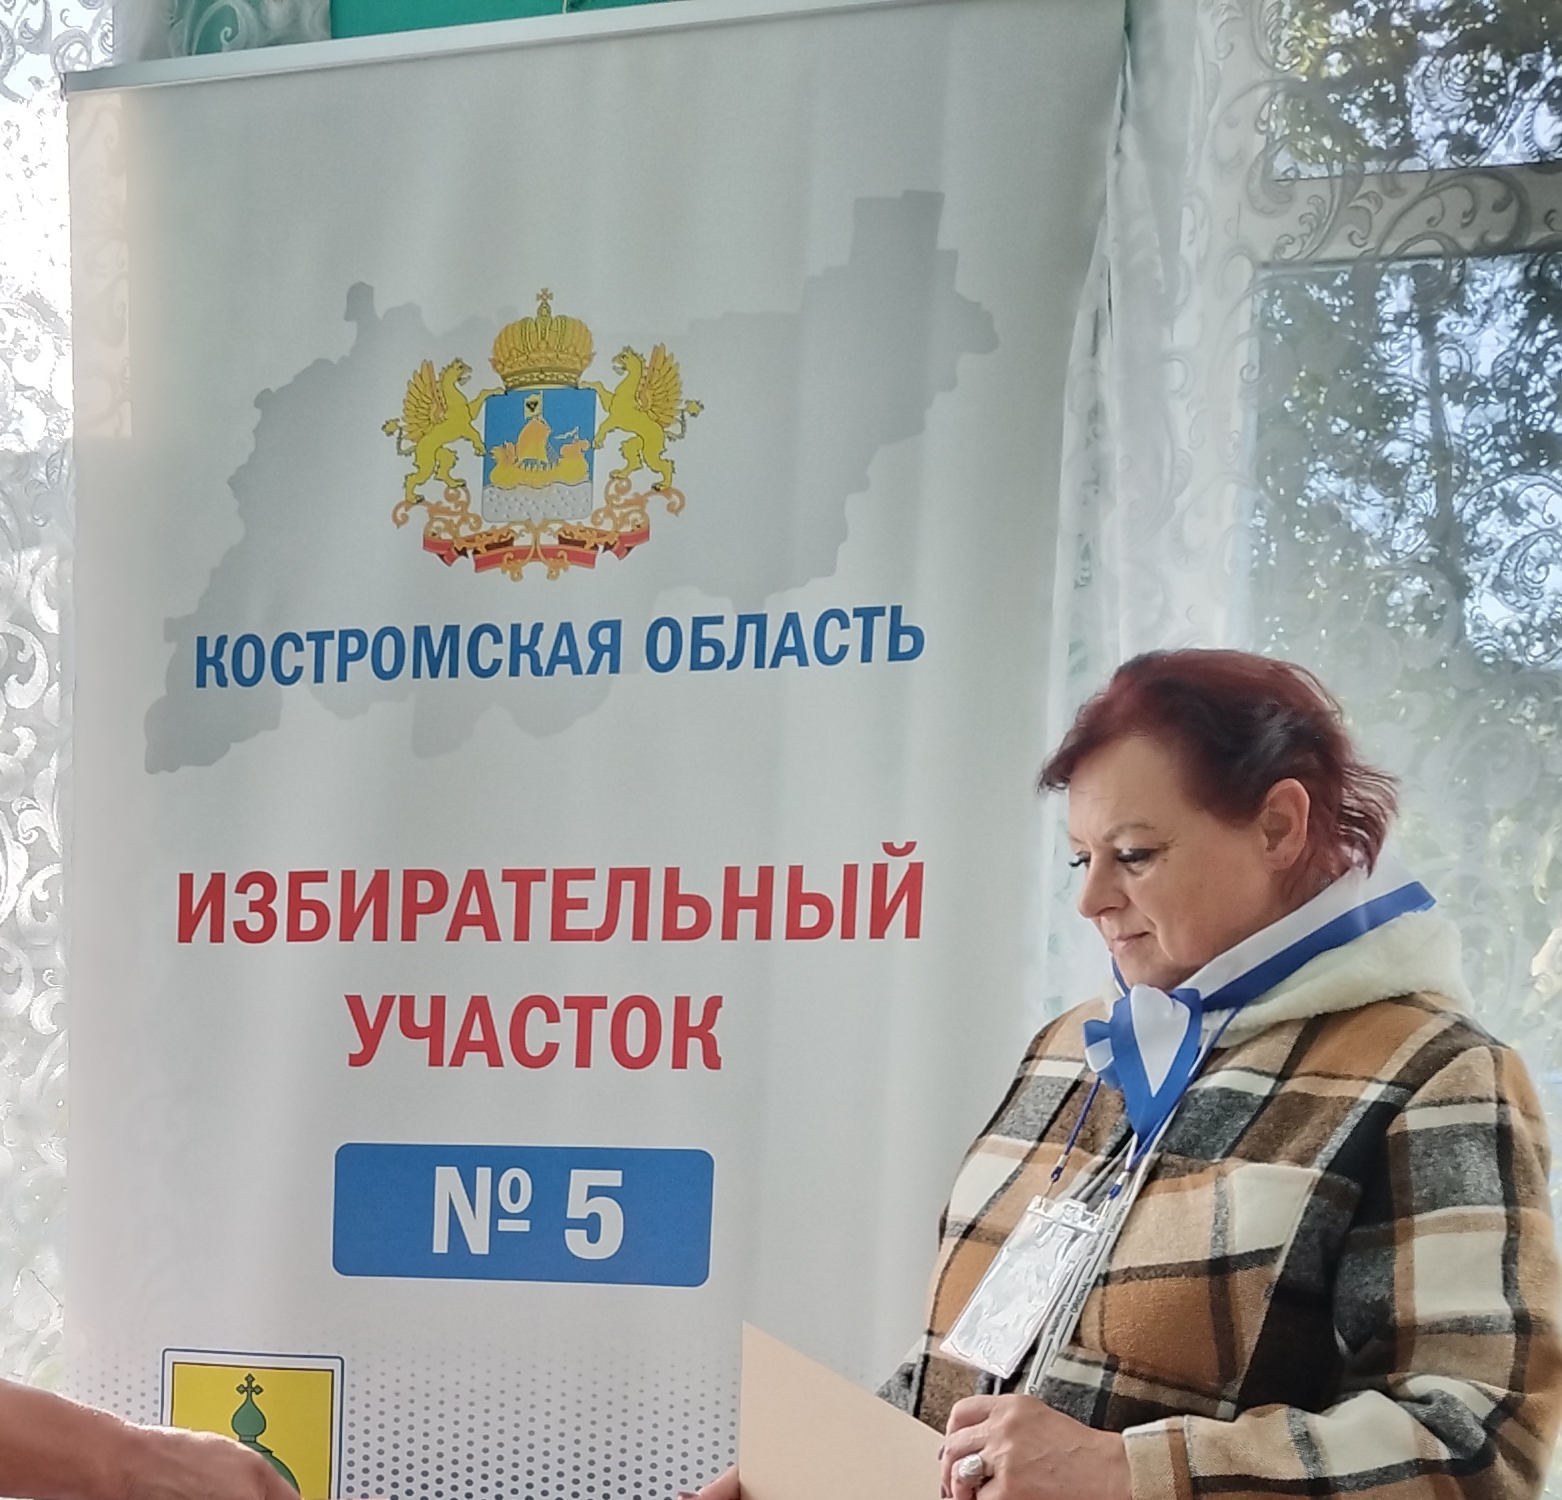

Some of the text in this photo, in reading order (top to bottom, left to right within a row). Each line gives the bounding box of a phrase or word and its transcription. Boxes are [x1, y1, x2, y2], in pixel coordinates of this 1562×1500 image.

[195, 605, 925, 689] КОСТРОМСКАЯ ОБЛАСТЬ
[177, 841, 925, 944] ИЗБИРАТЕЛЬНЫЙ
[344, 994, 723, 1071] УЧАСТОК
[432, 1166, 624, 1260] № 5
